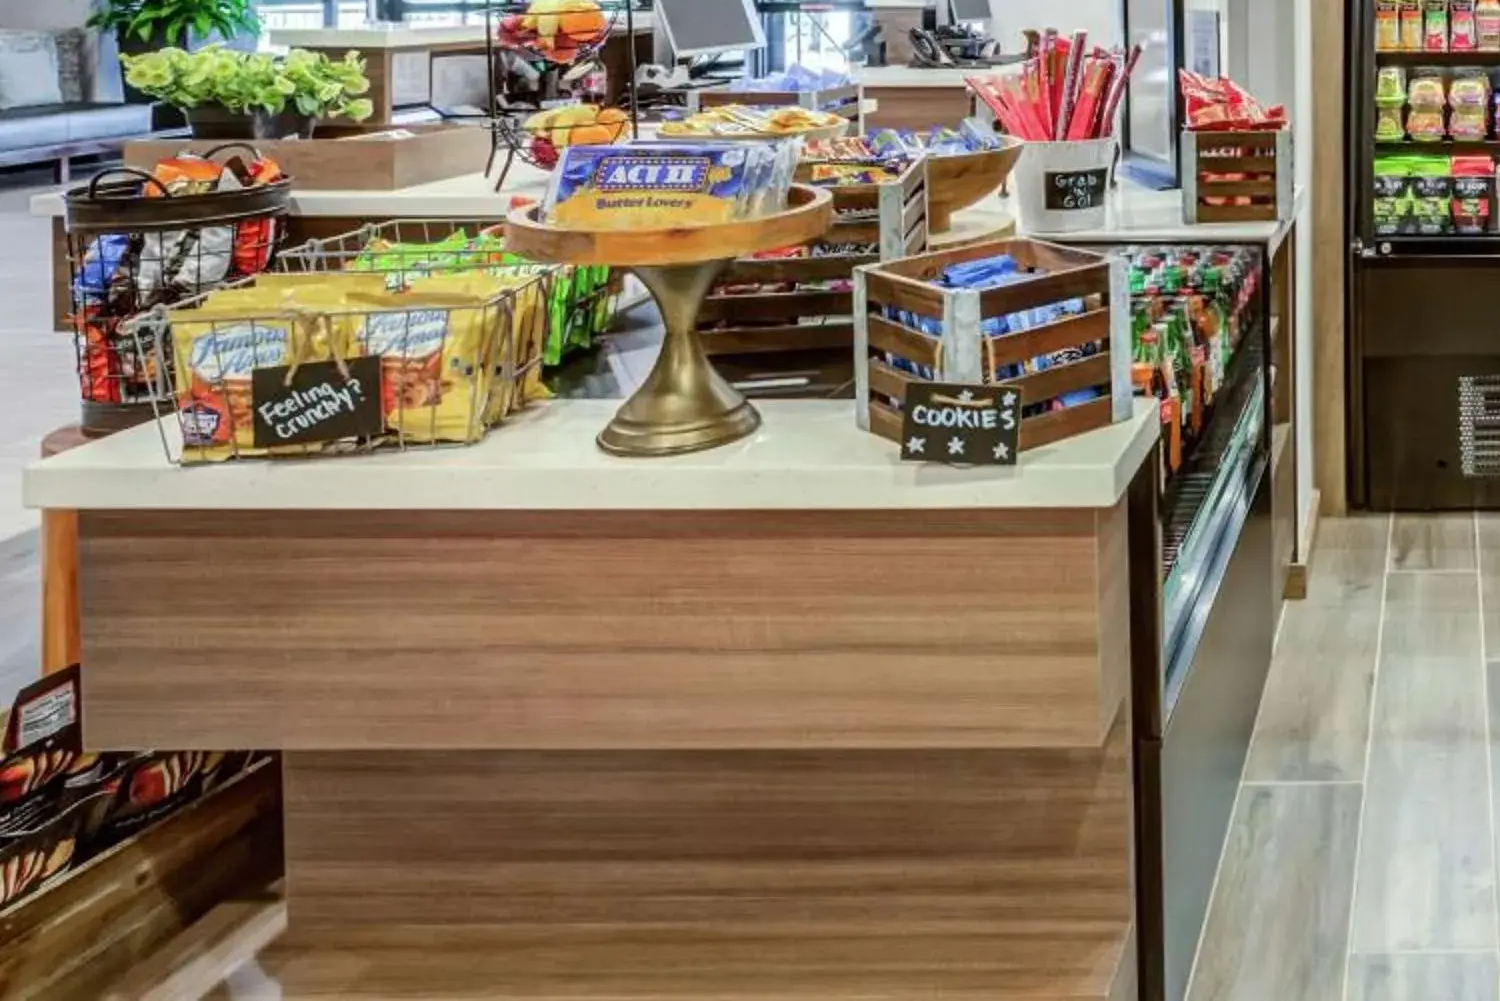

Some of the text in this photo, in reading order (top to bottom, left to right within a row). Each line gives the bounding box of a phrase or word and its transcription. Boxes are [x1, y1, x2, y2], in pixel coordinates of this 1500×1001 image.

[605, 165, 697, 184] ACT II
[596, 198, 645, 210] Butter
[258, 383, 336, 427] Feeling
[911, 404, 1016, 430] COOKIES
